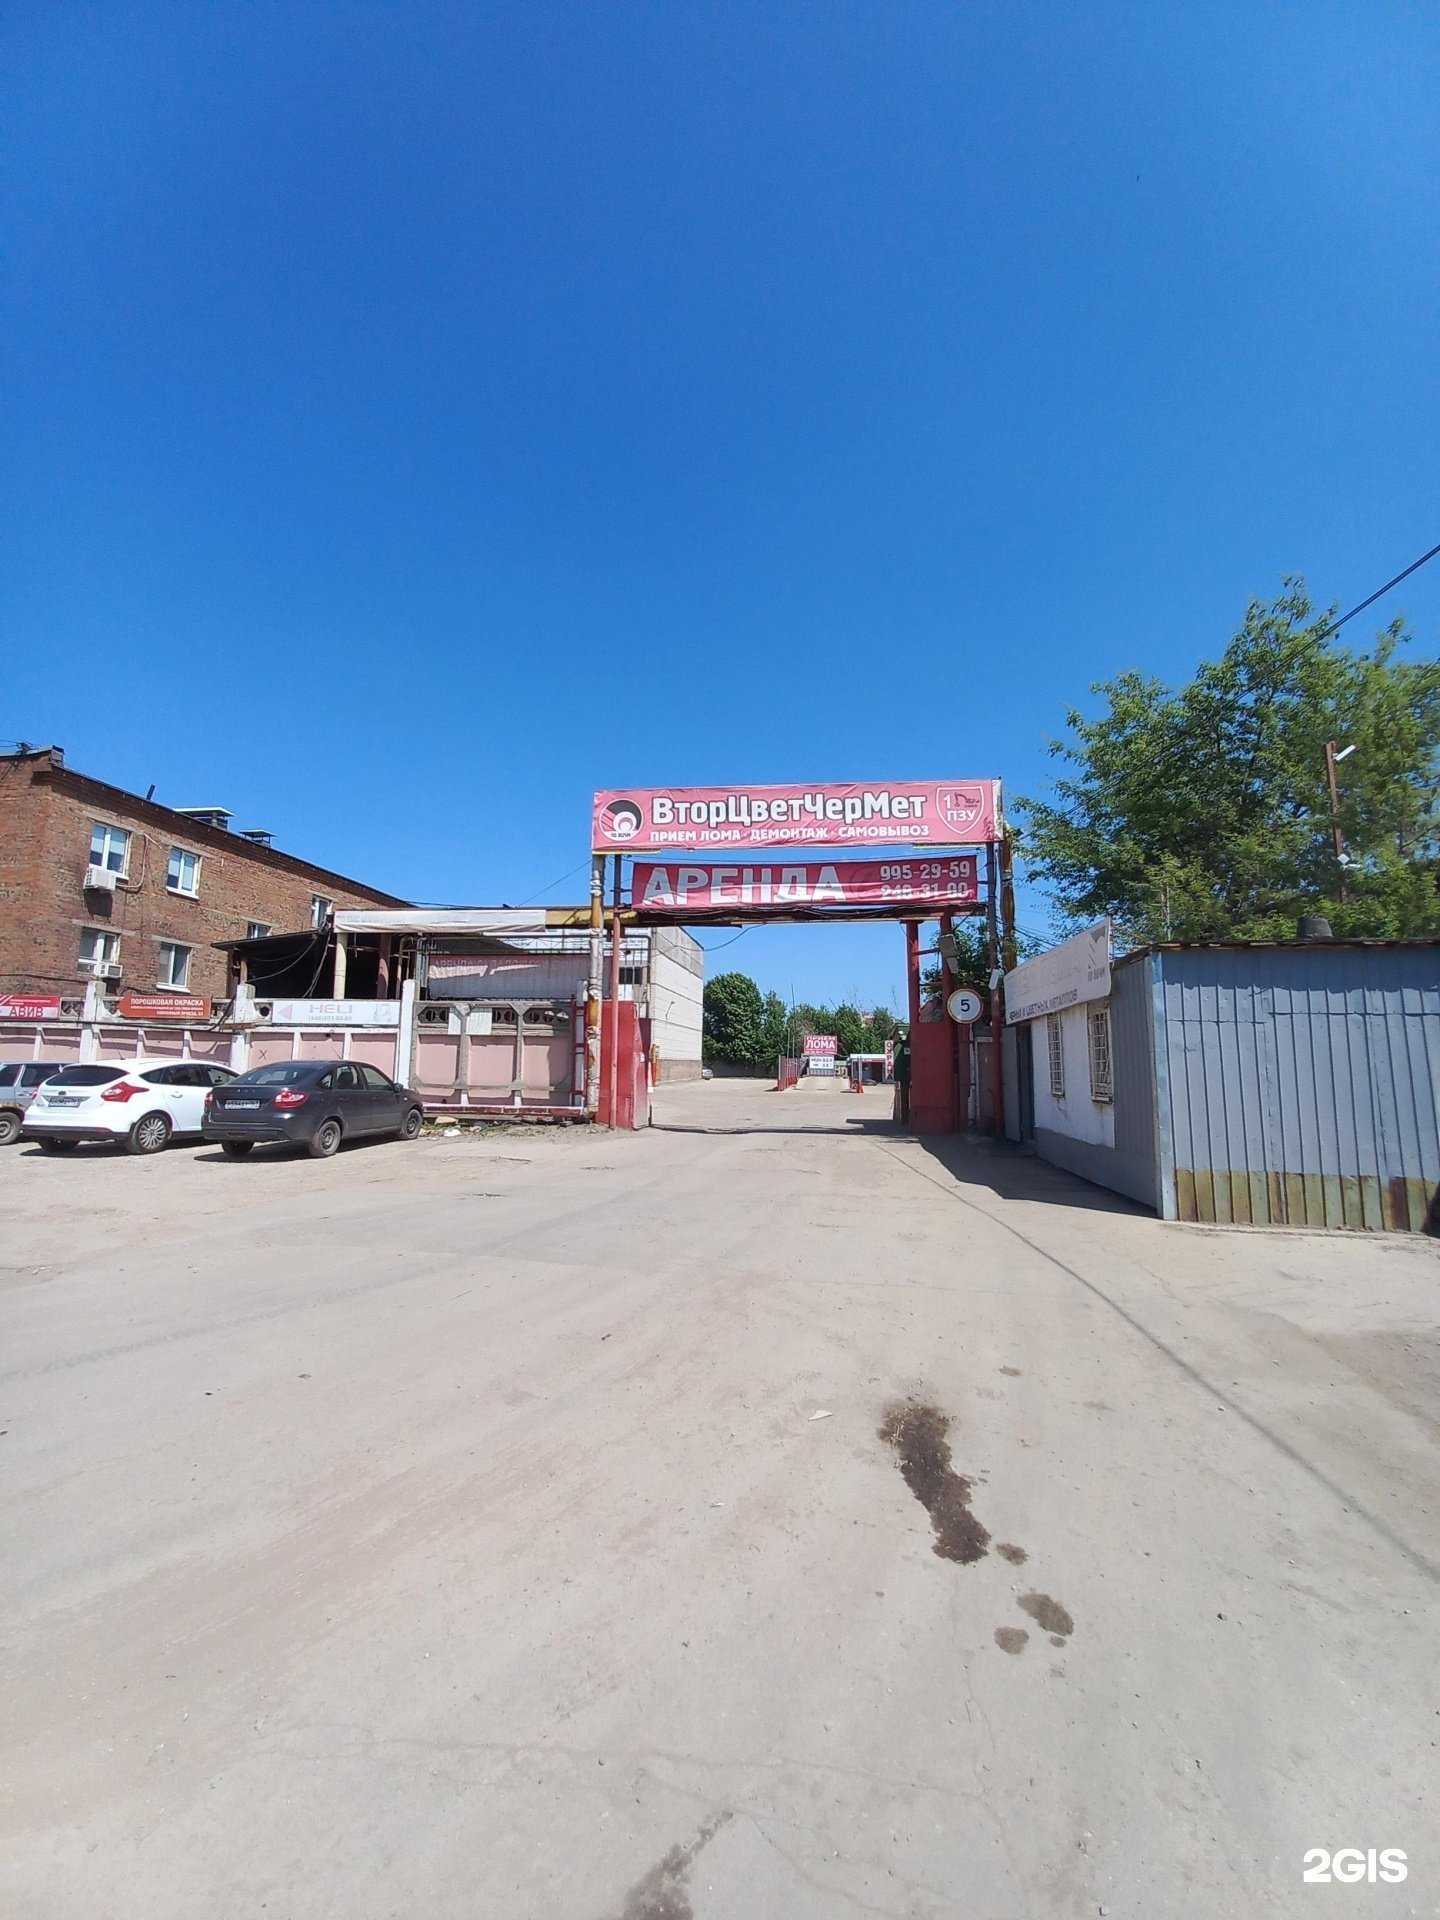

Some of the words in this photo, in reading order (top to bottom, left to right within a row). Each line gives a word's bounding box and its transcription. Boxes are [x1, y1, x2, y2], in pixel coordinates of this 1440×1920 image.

[944, 794, 951, 809] 1
[653, 791, 927, 828] ВторЦветЧерМет
[946, 809, 976, 822] ПЗУ
[650, 830, 696, 842] ПРИЕМ
[700, 829, 741, 842] ЛОМА
[749, 826, 828, 841] ДЕМОНТАЖ
[838, 824, 930, 838] САМОВЫВОЗ
[880, 860, 970, 881] 995-29-59
[642, 866, 849, 906] АРЕНДА
[131, 998, 174, 1006] ПОРОШКОВАЯ
[960, 999, 970, 1012] 5
[9, 1006, 44, 1017] АВИВ
[805, 1040, 836, 1049] ЛОМА
